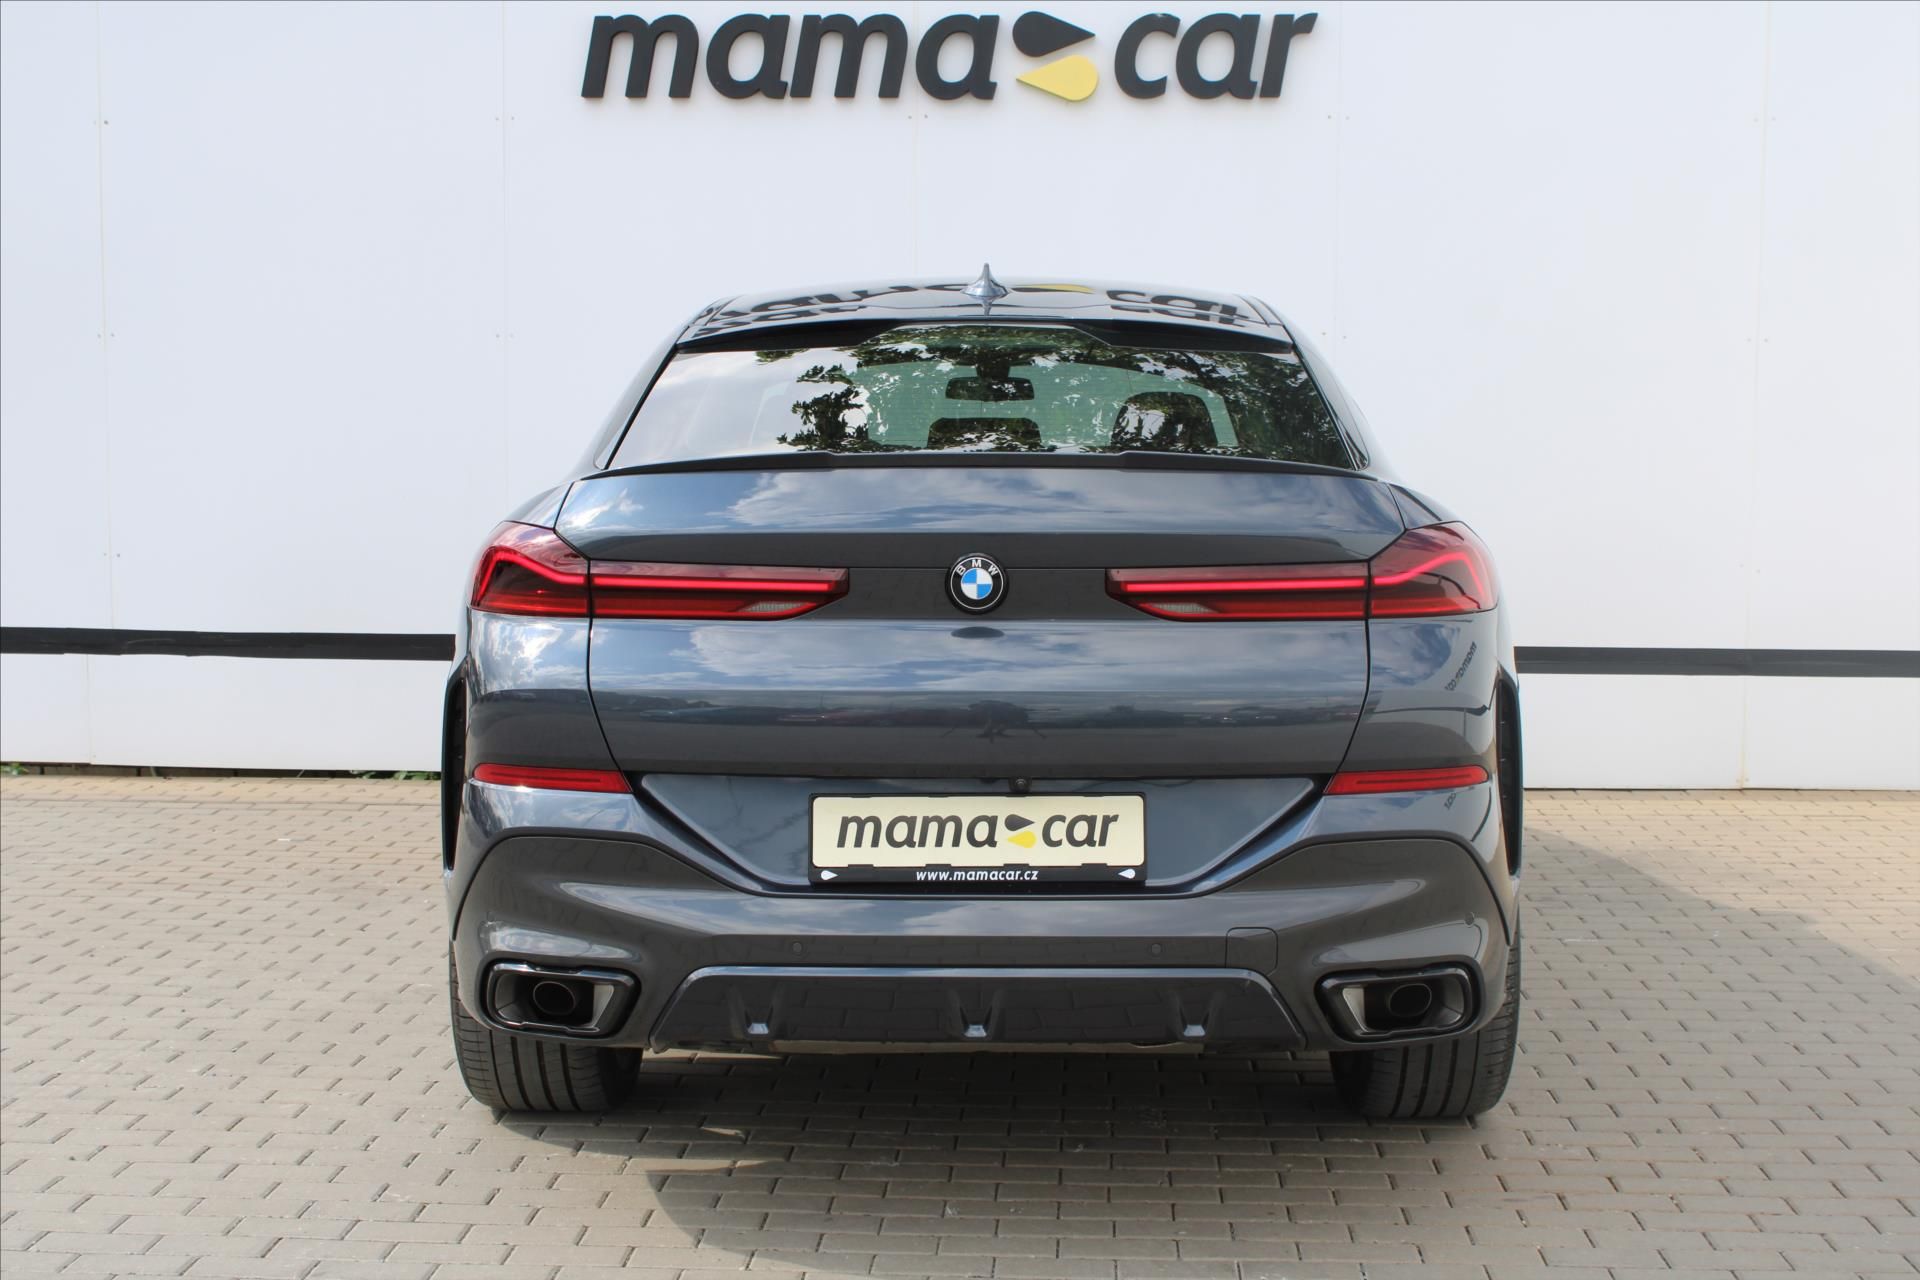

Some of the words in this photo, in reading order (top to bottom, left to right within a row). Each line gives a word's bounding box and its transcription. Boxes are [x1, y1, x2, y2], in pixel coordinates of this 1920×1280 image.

[582, 13, 999, 101] mama
[1114, 12, 1318, 101] car
[956, 559, 999, 576] BMW
[837, 813, 998, 848] mama
[1041, 813, 1119, 848] car
[915, 868, 1040, 882] www.mamacar.cz
